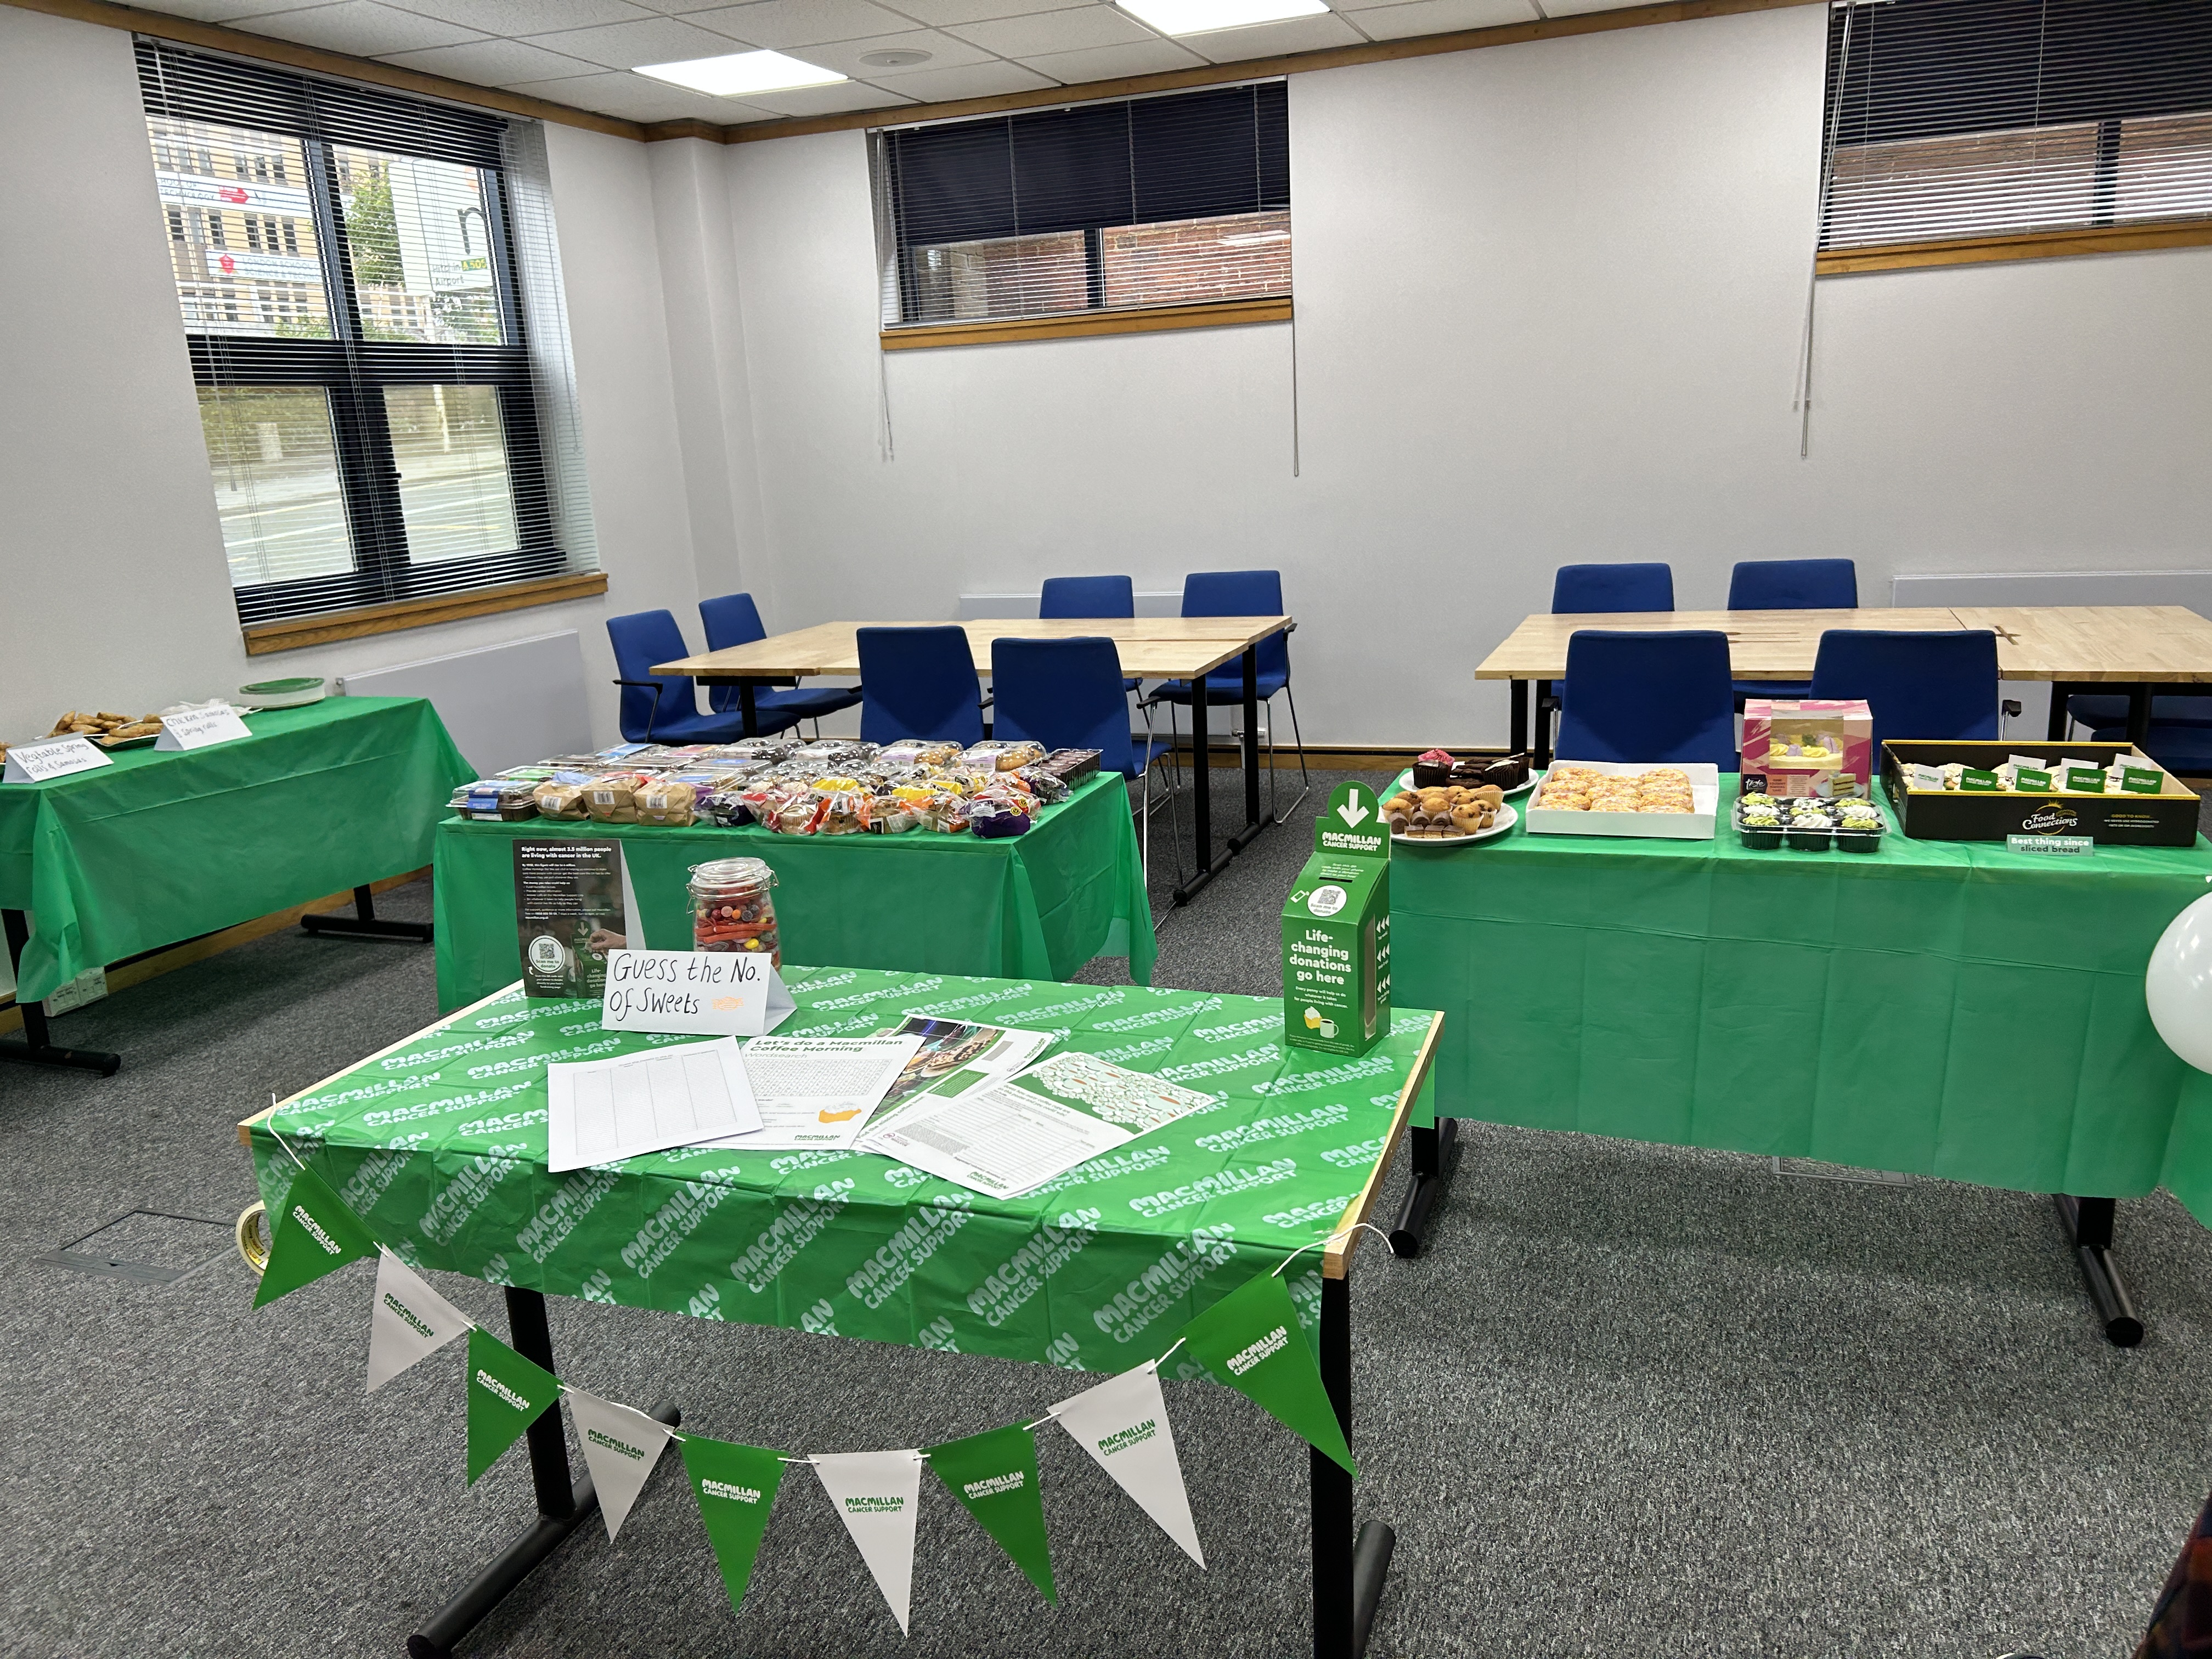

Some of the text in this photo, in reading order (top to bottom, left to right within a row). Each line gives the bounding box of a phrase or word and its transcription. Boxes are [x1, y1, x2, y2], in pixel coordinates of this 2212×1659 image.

[2022, 817, 2078, 830] Connections
[2031, 812, 2056, 822] Food
[1322, 831, 1381, 845] MACMILLAN
[1348, 843, 1378, 851] SUPPORT
[2011, 837, 2089, 847] Best thing since
[2052, 845, 2080, 854] bread
[1291, 941, 1349, 961] changing
[1305, 929, 1333, 943] Life-
[613, 953, 761, 984] Guess the No.
[1289, 953, 1352, 973] donations
[1296, 970, 1344, 985] go here
[636, 987, 701, 1014] Sweets
[812, 977, 943, 1009] MACMILLAN
[819, 985, 940, 1012] CANCER SUPPORT
[994, 990, 1126, 1023] MACMILLAN
[1003, 998, 1124, 1025] CANCER SUPPORT
[467, 1037, 622, 1076] MACMILLAN
[472, 1062, 540, 1080] CANCER
[543, 1046, 615, 1064] SUPPORT
[276, 1072, 441, 1111] MACMILLAN
[276, 1080, 436, 1116] CANCER SUPPORT
[1195, 1103, 1349, 1148] MACMILLAN
[1207, 1113, 1350, 1153] CANCER SUPPORT
[419, 1142, 528, 1238] MACMILLAN
[435, 1150, 522, 1247] CANCER SUPPORT
[1128, 1158, 1297, 1212] MACMILLAN
[1142, 1169, 1299, 1218] CANCER SUPPORT
[292, 1211, 335, 1255] CANCER SUPPORT
[295, 1205, 342, 1254] MACMILLAN
[620, 1166, 741, 1268] MACMILLAN
[637, 1176, 737, 1279] CANCER SUPPORT
[730, 1177, 855, 1282] MACMILLAN
[748, 1192, 850, 1294] CANCER SUPPORT
[845, 1190, 975, 1299] MACMILLAN
[864, 1201, 975, 1310] CANCER SUPPORT
[966, 1206, 1102, 1316] MACMILLAN
[985, 1220, 1102, 1327] CANCER SUPPORT
[1093, 1222, 1235, 1333] MACMILLAN
[1113, 1237, 1237, 1344] CANCER SUPPORT
[383, 1299, 429, 1339] CANCER SUPPORT
[385, 1293, 435, 1338] MACMILLAN
[1227, 1325, 1288, 1372] MACMILLAN
[1233, 1336, 1289, 1376] CANCER SUPPORT
[476, 1376, 524, 1412] CANCER SUPPORT
[477, 1369, 531, 1409] MACMILLAN
[587, 1429, 645, 1458] MACMILLAN
[588, 1436, 641, 1462] CANCER SUPPORT
[1098, 1419, 1156, 1451] MACMILLAN
[1103, 1429, 1156, 1457] CANCER SUPPORT
[701, 1479, 761, 1499] MACMILLAN
[703, 1487, 758, 1504] CANCER SUPPORT
[963, 1470, 1025, 1494] MACMILLAN
[968, 1480, 1024, 1499] CANCER SUPPORT
[845, 1496, 905, 1507] MACMILLAN
[848, 1505, 902, 1513] CANCER SUPPORT
